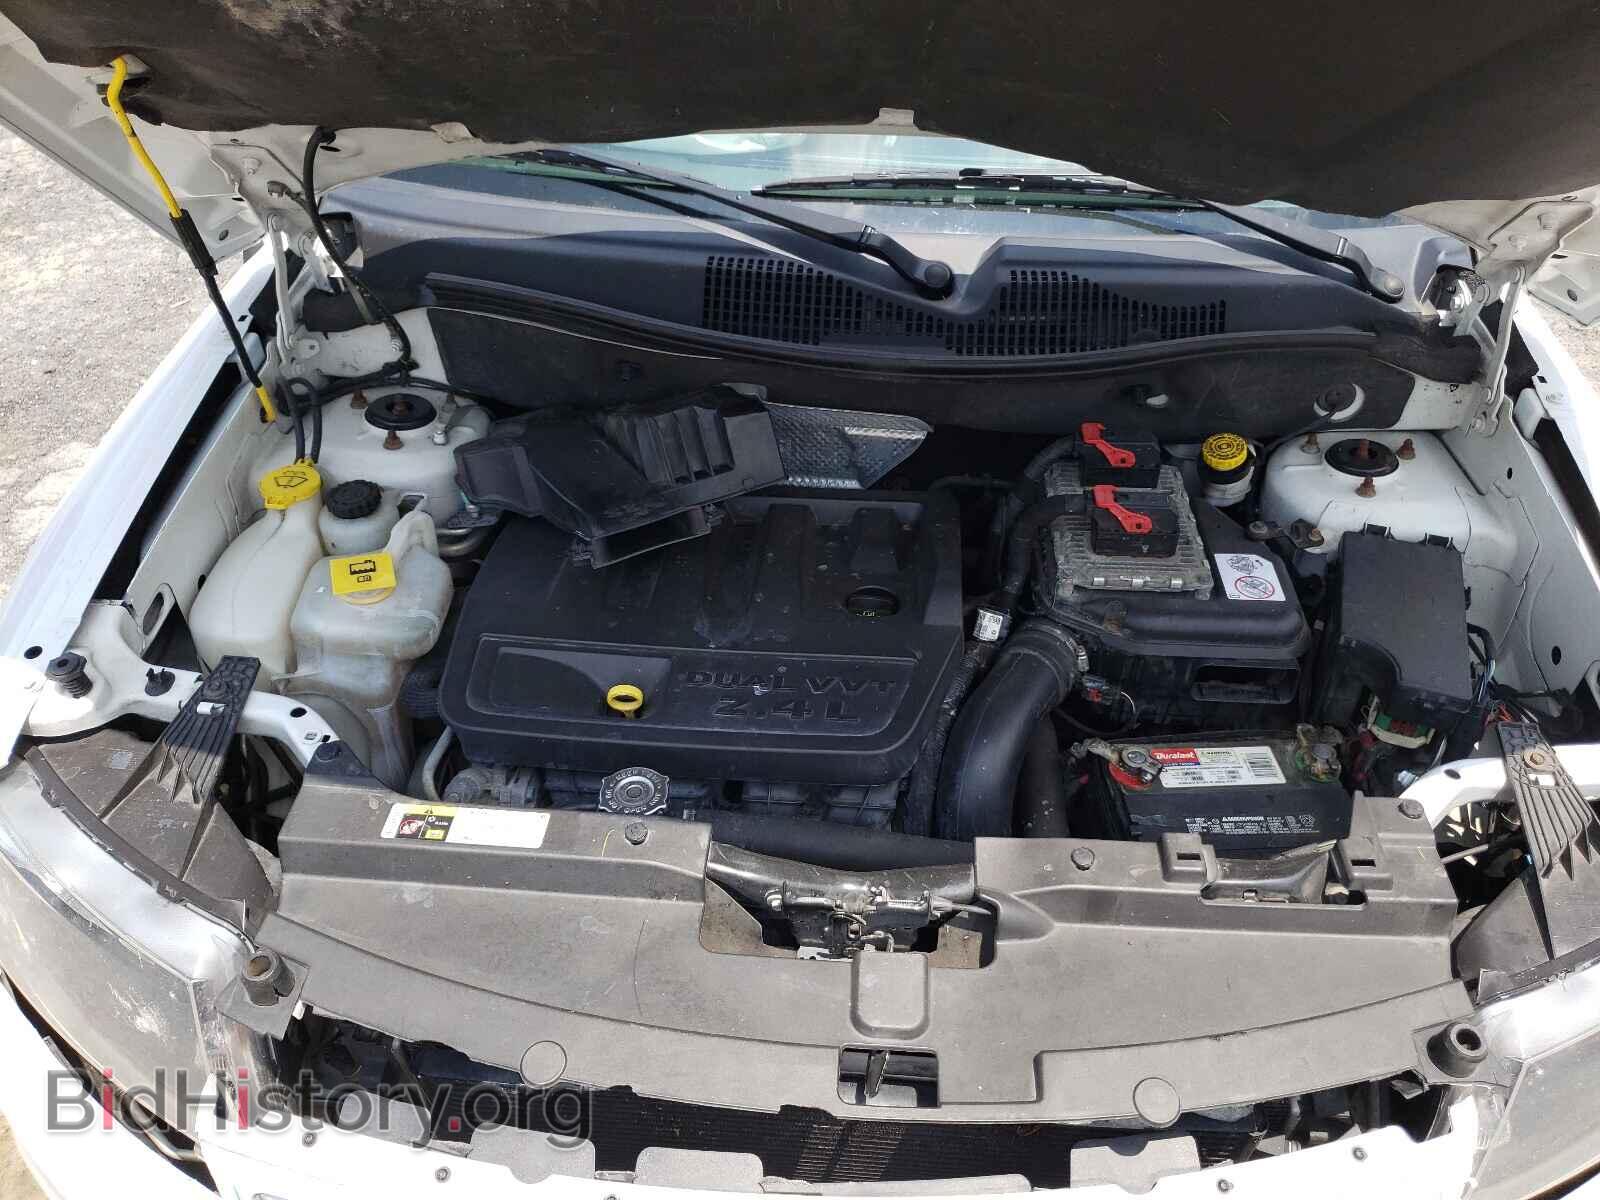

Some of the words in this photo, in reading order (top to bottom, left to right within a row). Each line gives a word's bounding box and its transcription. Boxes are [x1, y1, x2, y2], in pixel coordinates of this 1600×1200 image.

[686, 671, 797, 694] DUAL
[805, 676, 897, 695] VVT
[711, 698, 862, 721] 2.4L
[1154, 751, 1196, 760] Duralast
